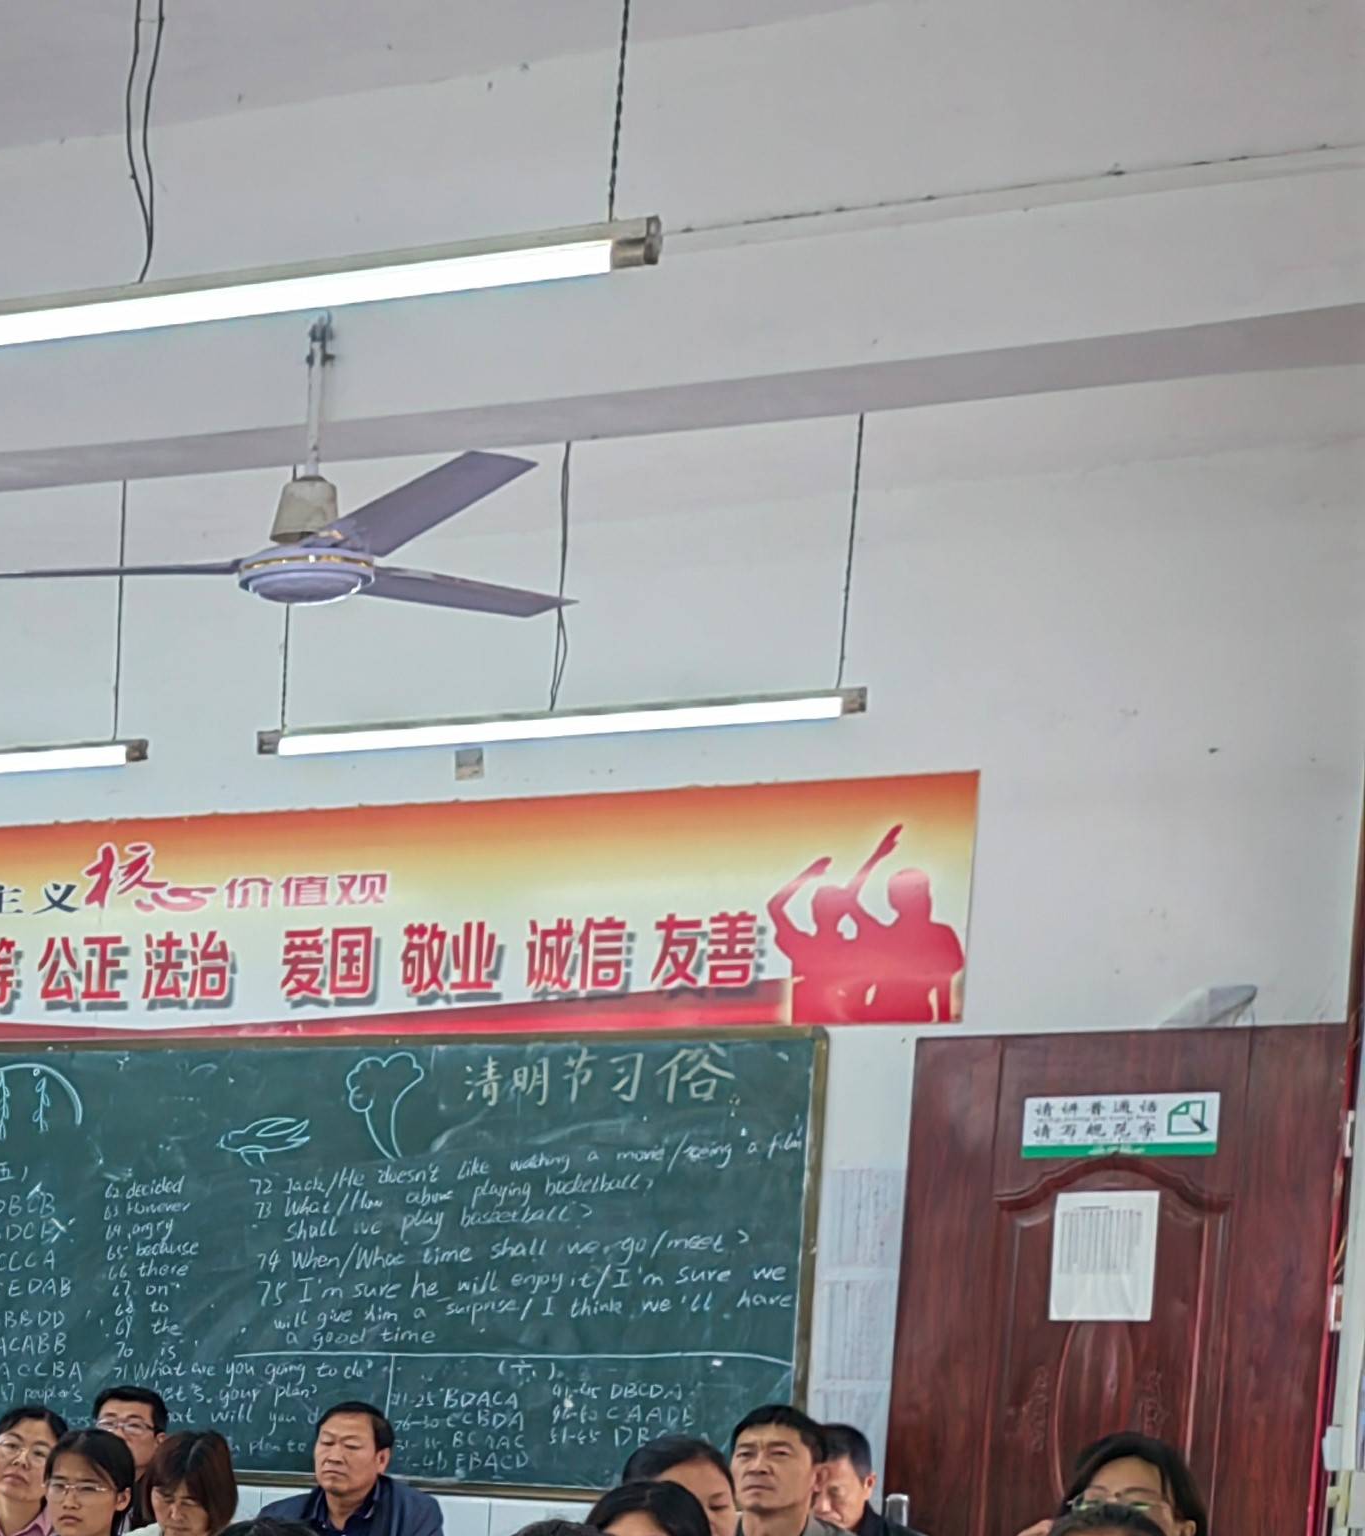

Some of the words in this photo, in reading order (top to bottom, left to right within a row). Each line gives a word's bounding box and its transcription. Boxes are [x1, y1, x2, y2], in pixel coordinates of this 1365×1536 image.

[38, 933, 122, 1001] 公正
[142, 932, 230, 999] 法治
[281, 926, 373, 996] 爱国
[400, 921, 495, 992] 敬业
[524, 917, 629, 989] 诚信
[651, 911, 758, 985] 友善
[464, 1044, 736, 1107] 清明节习俗
[352, 1281, 402, 1299] sure
[411, 1271, 440, 1298] he
[458, 1270, 500, 1294] will
[675, 1267, 732, 1284] sure
[753, 1266, 788, 1281] we
[380, 1329, 437, 1344] time
